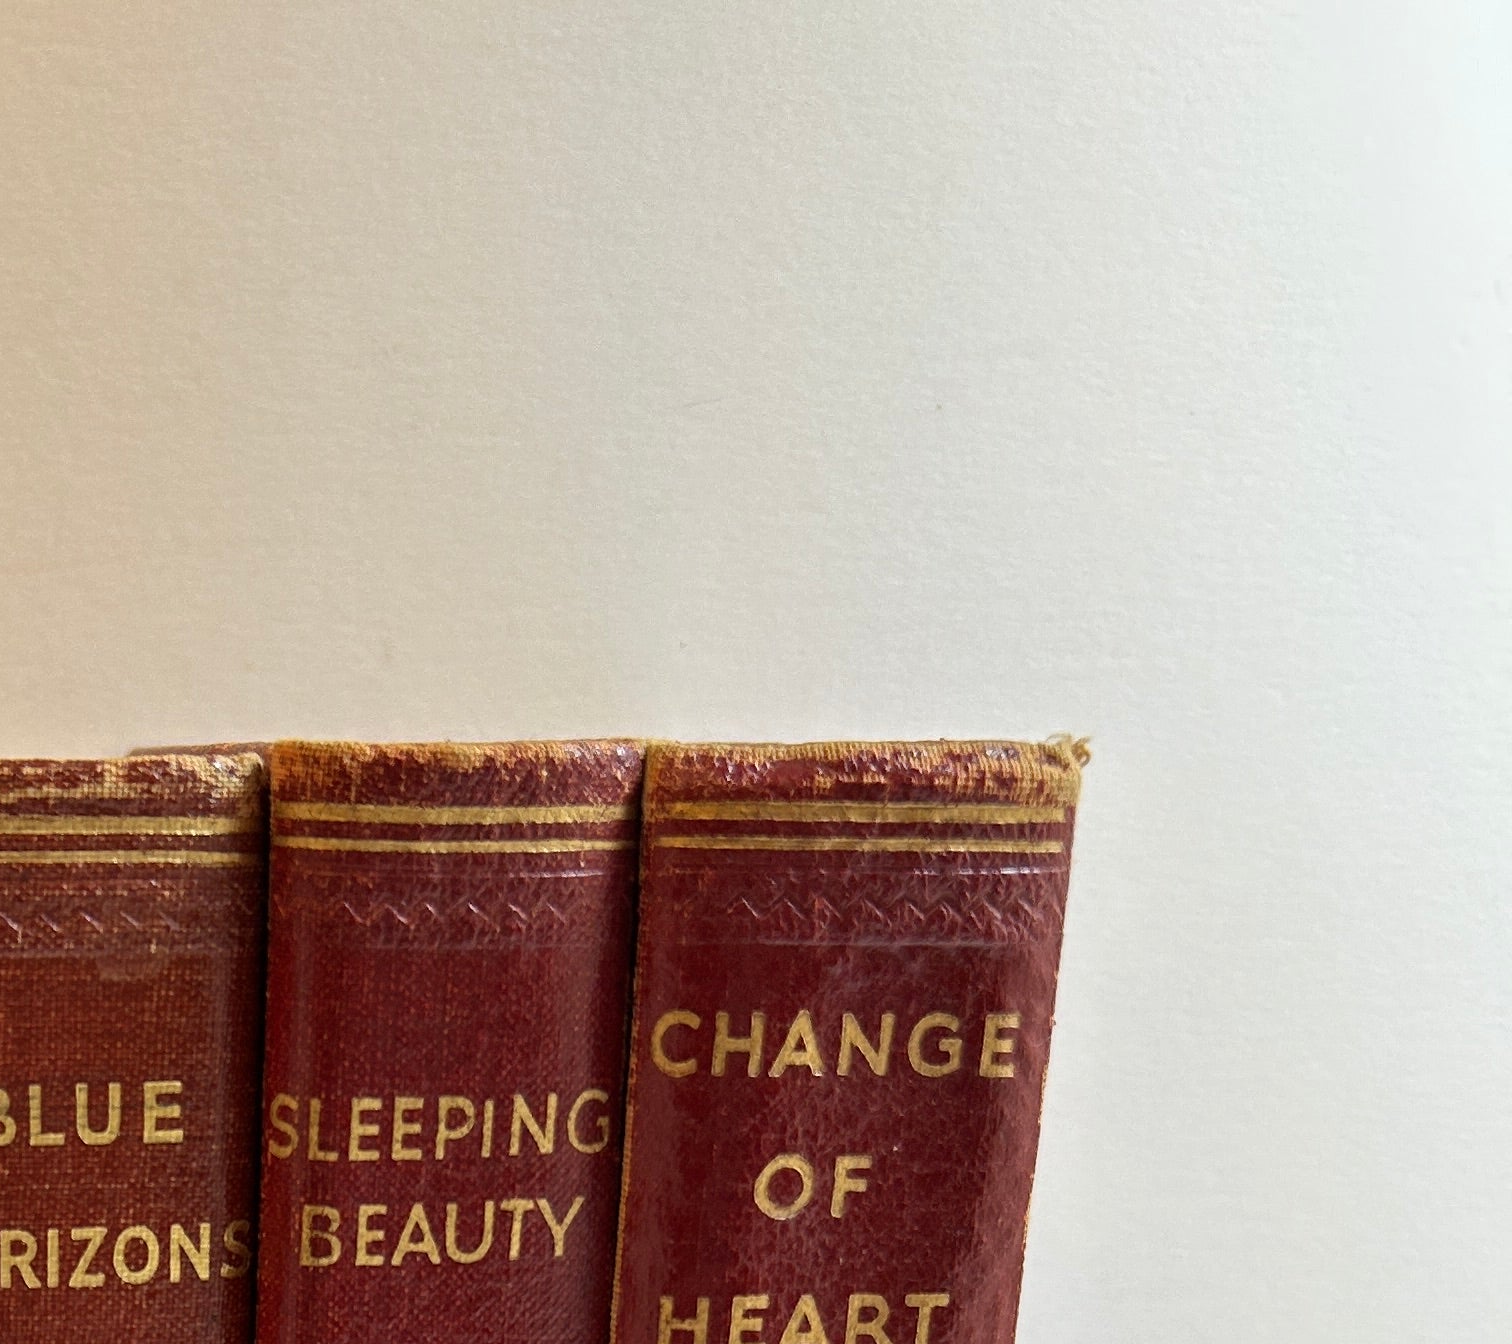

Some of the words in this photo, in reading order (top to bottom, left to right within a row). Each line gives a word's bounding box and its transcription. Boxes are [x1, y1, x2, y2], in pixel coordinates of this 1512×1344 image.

[650, 1010, 1023, 1079] CHANGE
[268, 1088, 610, 1163] SLEEPING
[754, 1154, 872, 1220] OF
[300, 1197, 584, 1268] BEAUTY
